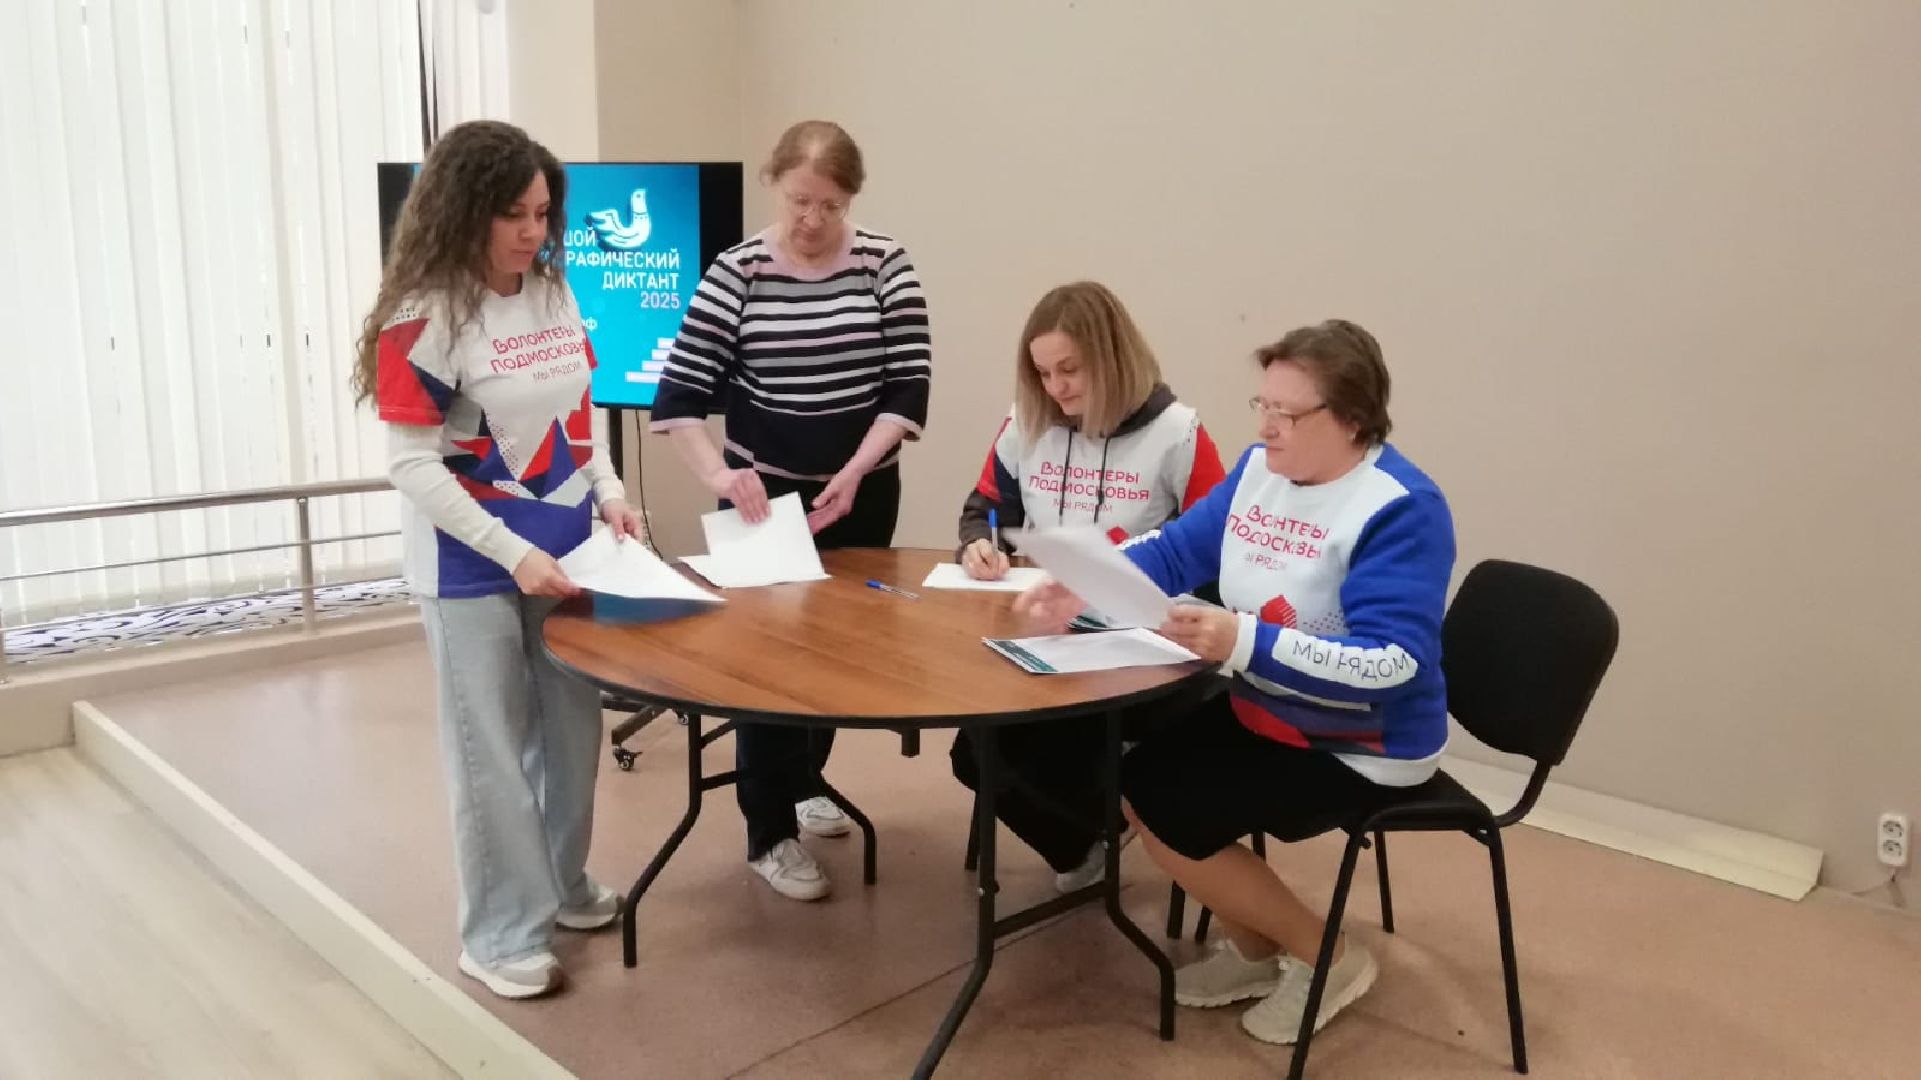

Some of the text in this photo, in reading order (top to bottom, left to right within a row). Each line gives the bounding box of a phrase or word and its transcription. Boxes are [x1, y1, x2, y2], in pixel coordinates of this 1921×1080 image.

[563, 227, 596, 247] ШОЙ
[565, 248, 680, 269] РАФИЧЕСКИЙ
[602, 271, 679, 290] ДИКТАНТ
[640, 291, 680, 309] 2025
[1293, 640, 1332, 667] МЫ
